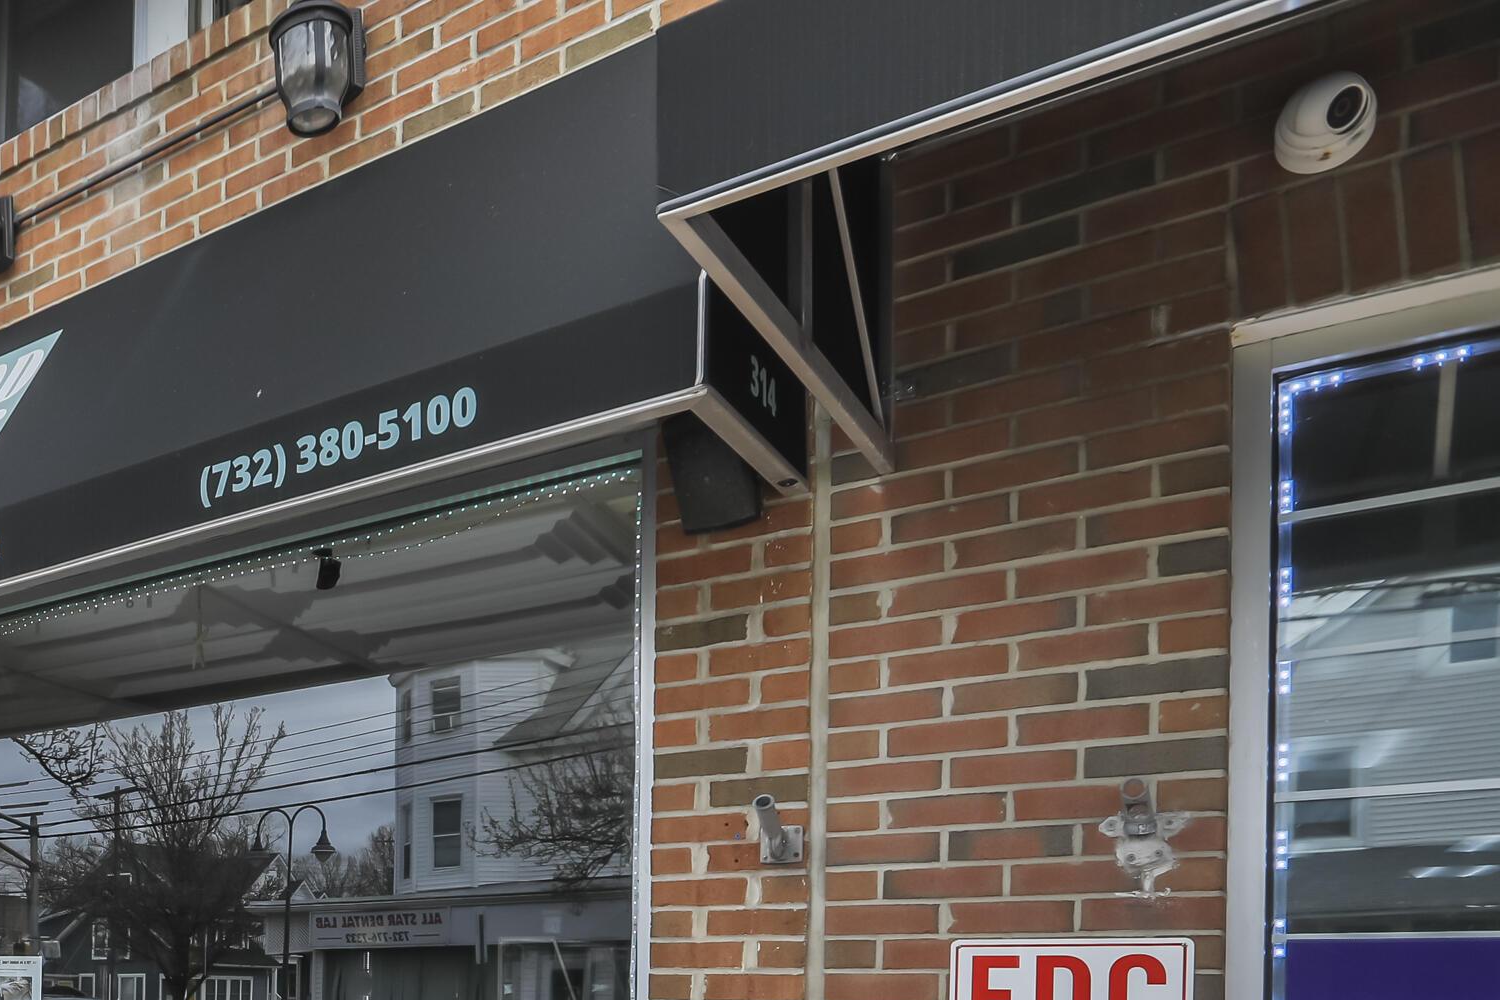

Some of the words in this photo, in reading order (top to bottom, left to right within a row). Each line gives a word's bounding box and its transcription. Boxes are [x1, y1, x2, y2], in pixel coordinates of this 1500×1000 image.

[750, 354, 777, 417] 314
[200, 443, 287, 508] (732)
[296, 386, 478, 474] 380-5100
